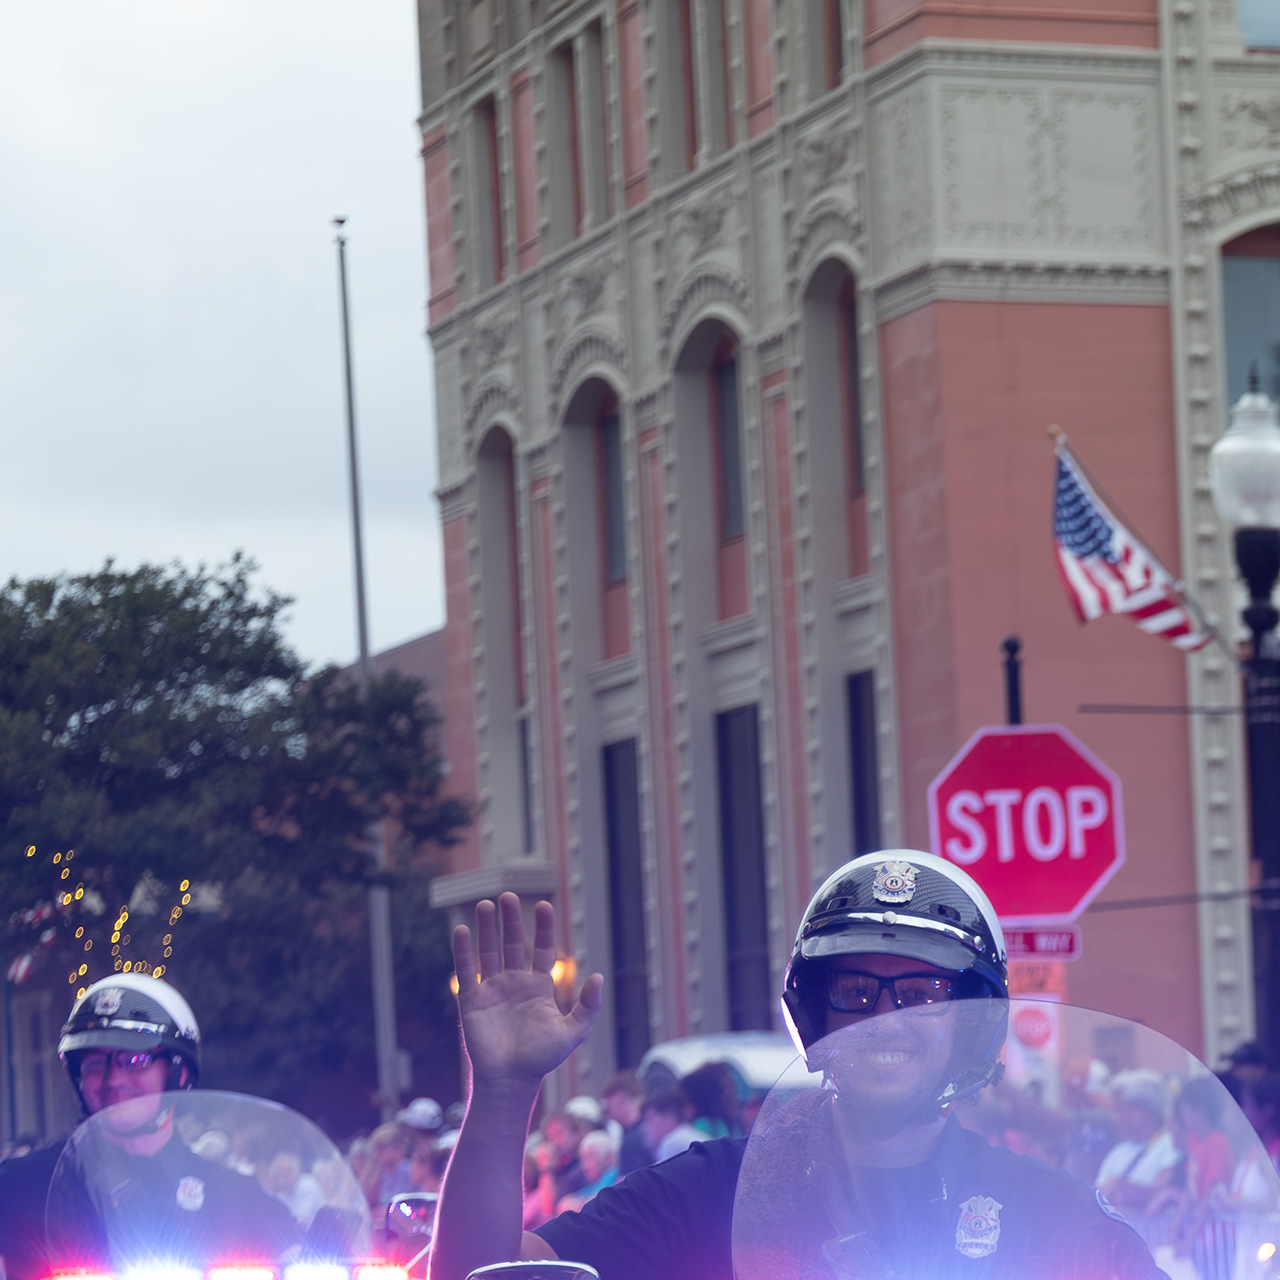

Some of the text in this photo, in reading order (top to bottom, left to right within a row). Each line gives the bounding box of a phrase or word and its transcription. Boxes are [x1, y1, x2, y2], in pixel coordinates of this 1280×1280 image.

[945, 785, 1108, 865] STOP
[1005, 932, 1071, 951] LL WAY
